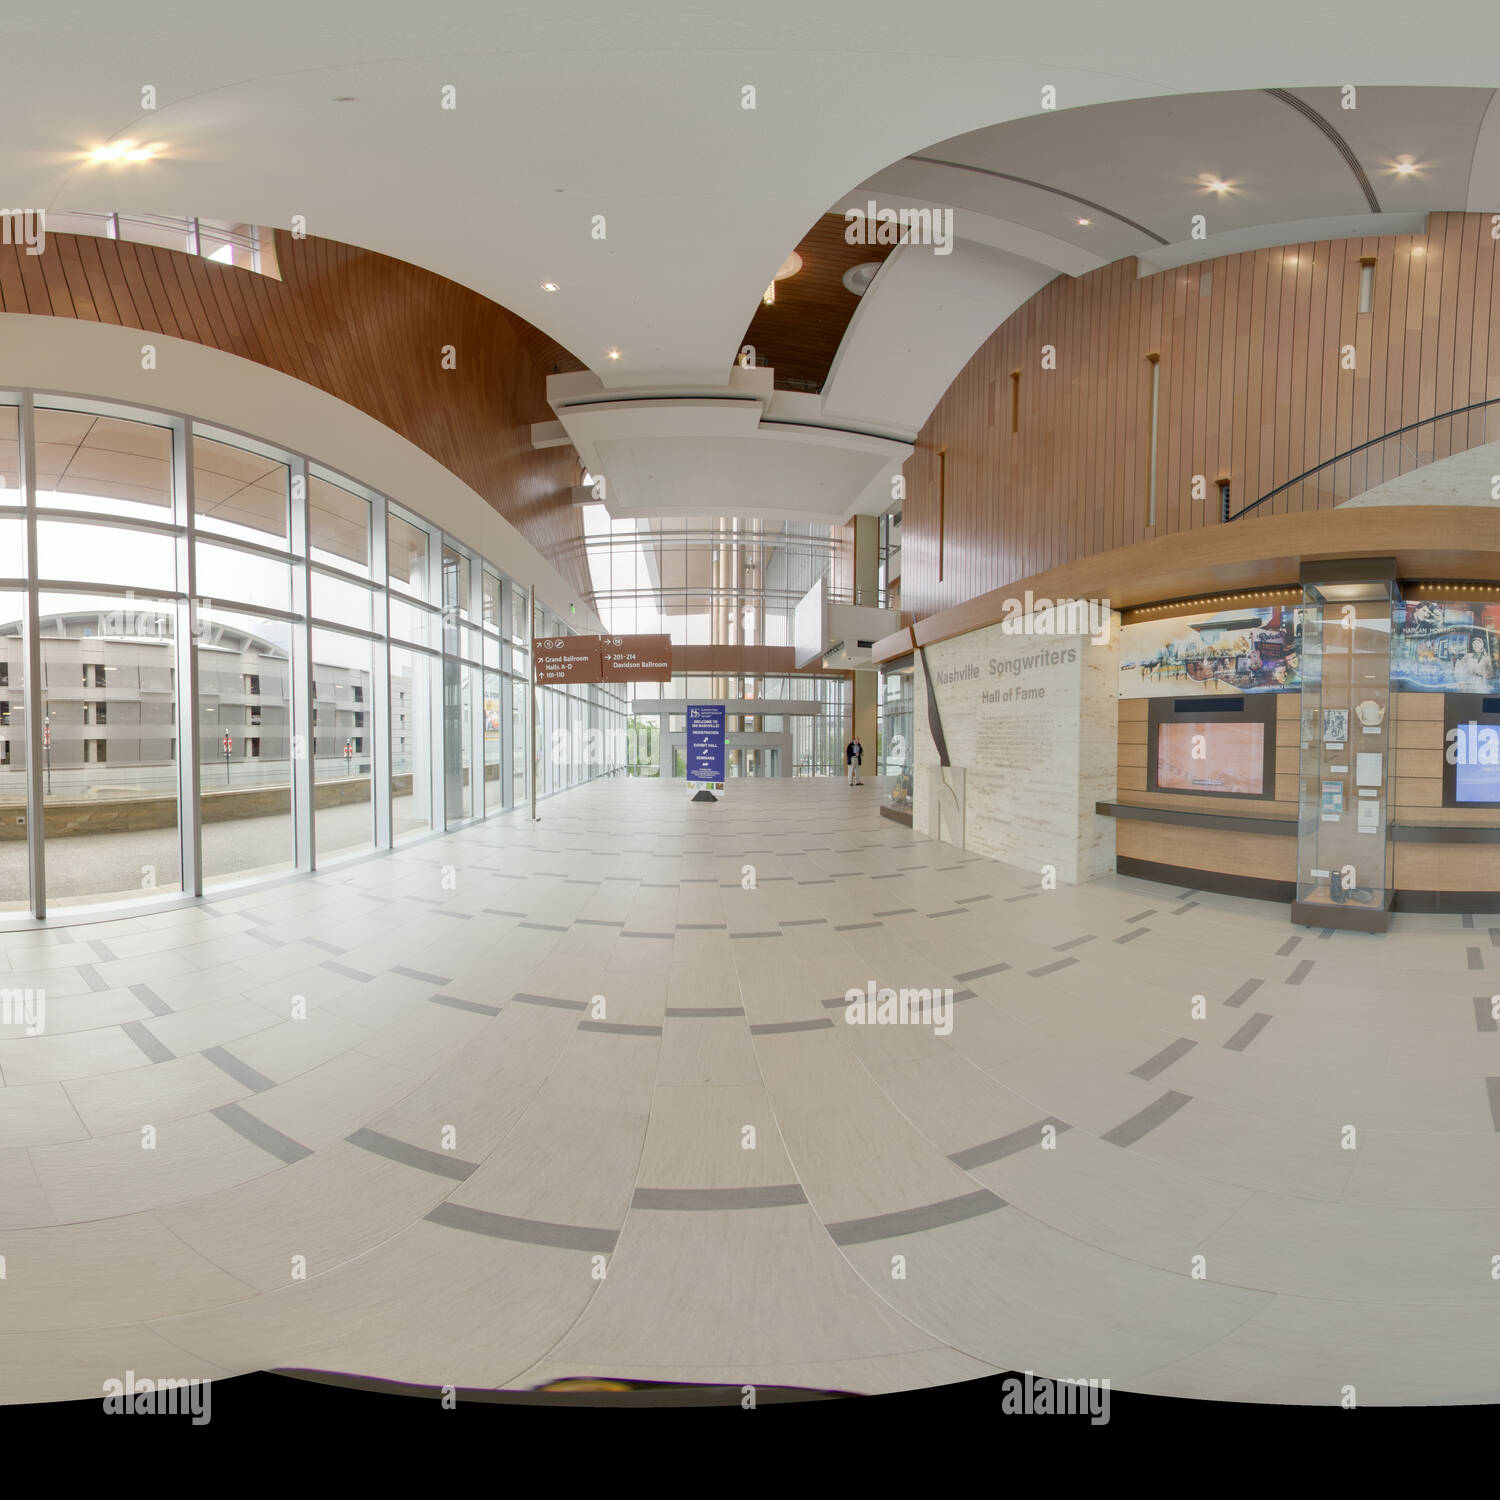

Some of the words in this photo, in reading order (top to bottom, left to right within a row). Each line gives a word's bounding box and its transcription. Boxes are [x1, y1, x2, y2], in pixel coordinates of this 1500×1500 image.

[937, 664, 980, 685] Nashville
[988, 648, 1077, 676] Songwriters
[982, 690, 1000, 704] Hall
[1003, 688, 1013, 702] of
[1015, 686, 1046, 701] Fame
